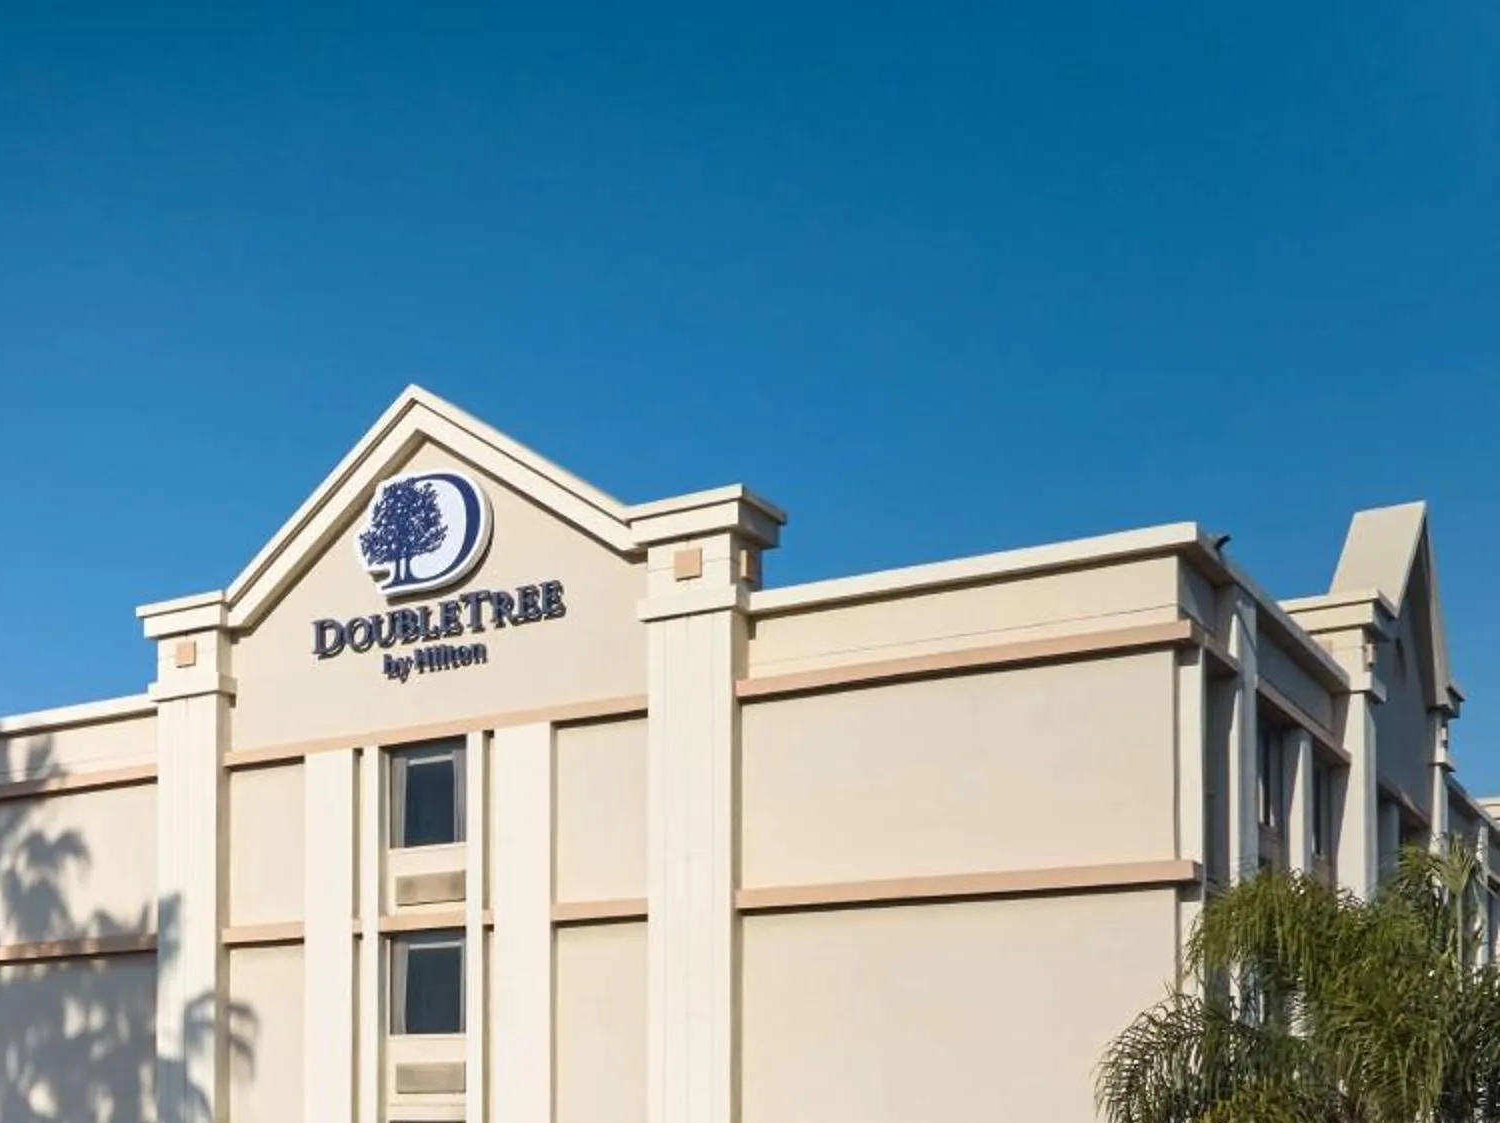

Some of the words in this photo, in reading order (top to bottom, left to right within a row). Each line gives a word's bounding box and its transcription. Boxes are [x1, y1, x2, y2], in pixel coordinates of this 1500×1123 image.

[312, 580, 566, 660] DOUBLETREE
[383, 653, 412, 684] by
[414, 643, 488, 675] Hilton
